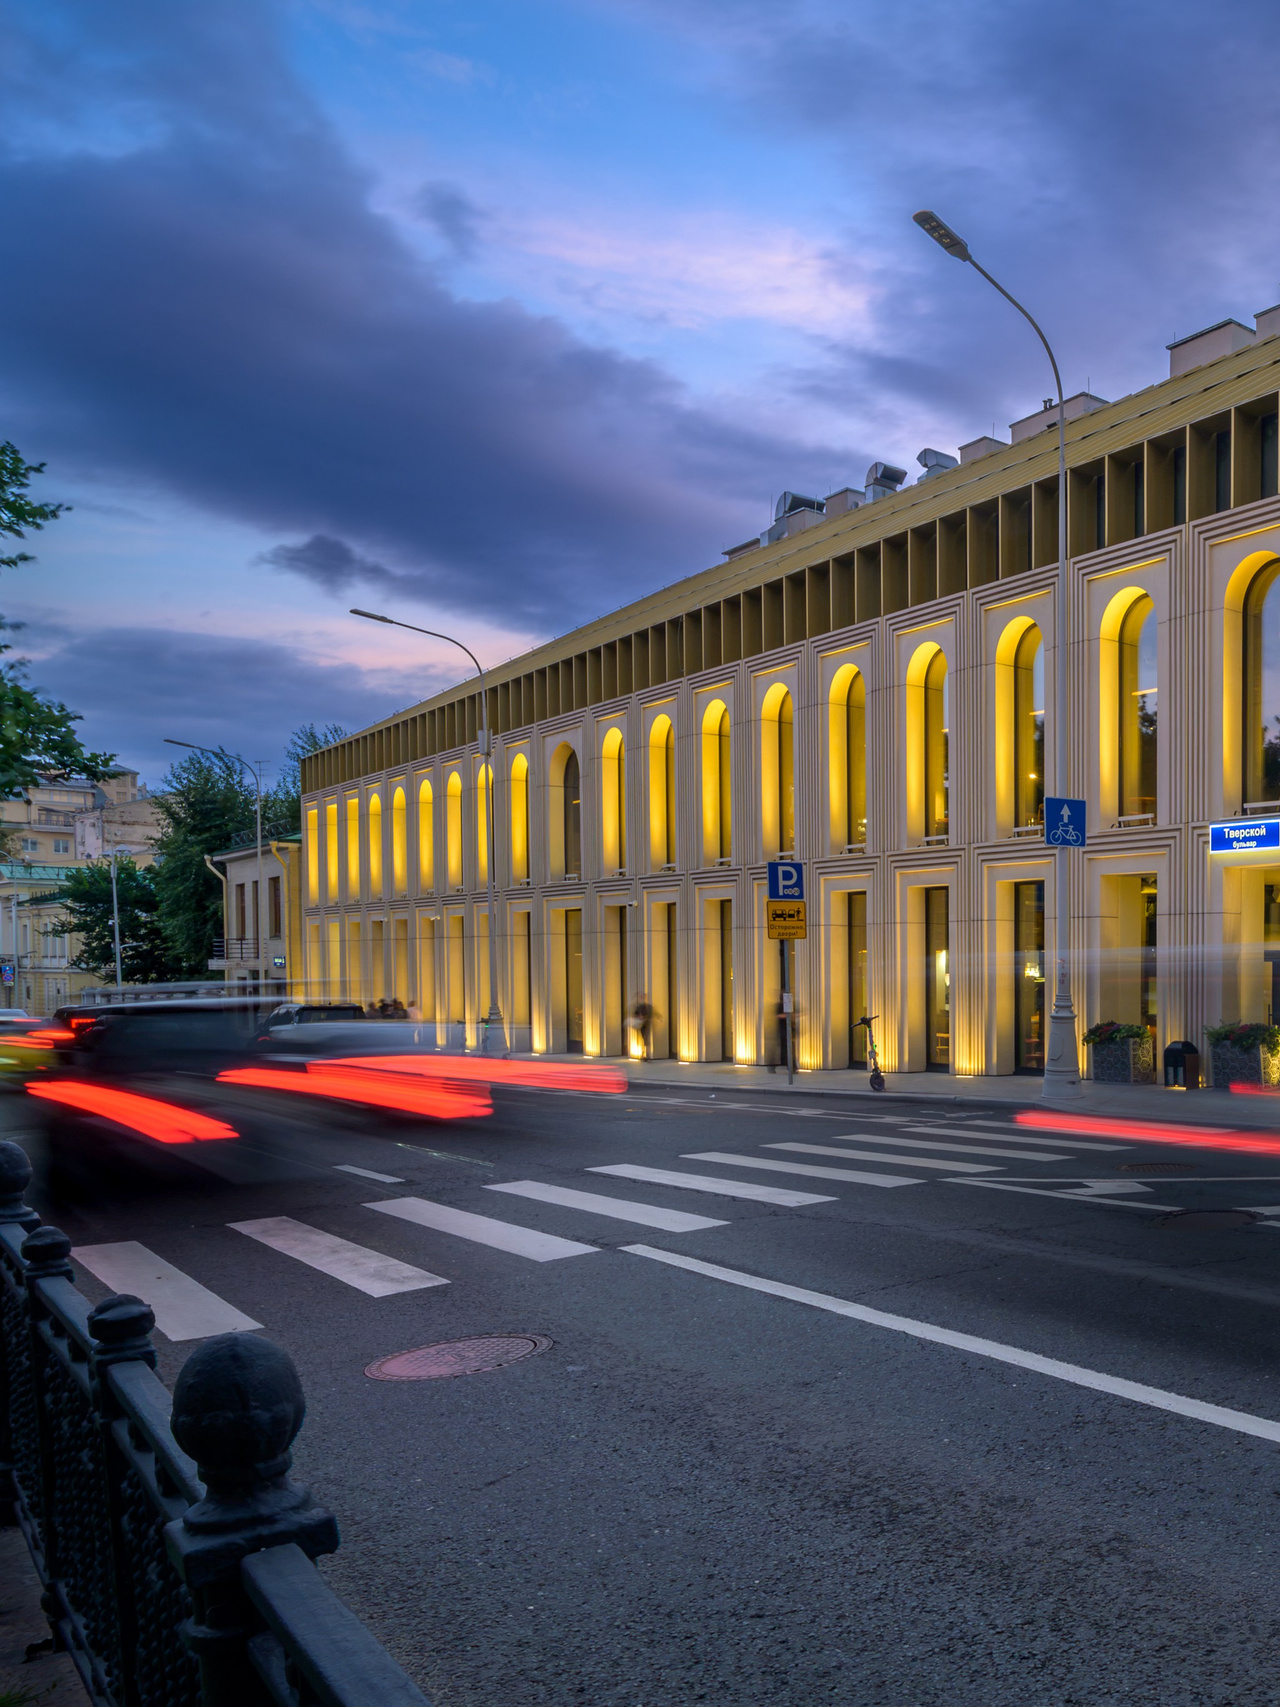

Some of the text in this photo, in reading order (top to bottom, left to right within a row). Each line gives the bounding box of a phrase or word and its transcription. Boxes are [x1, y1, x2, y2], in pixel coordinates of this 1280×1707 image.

[1223, 825, 1266, 840] Тверской
[1232, 840, 1257, 849] бульвар
[778, 866, 798, 896] P
